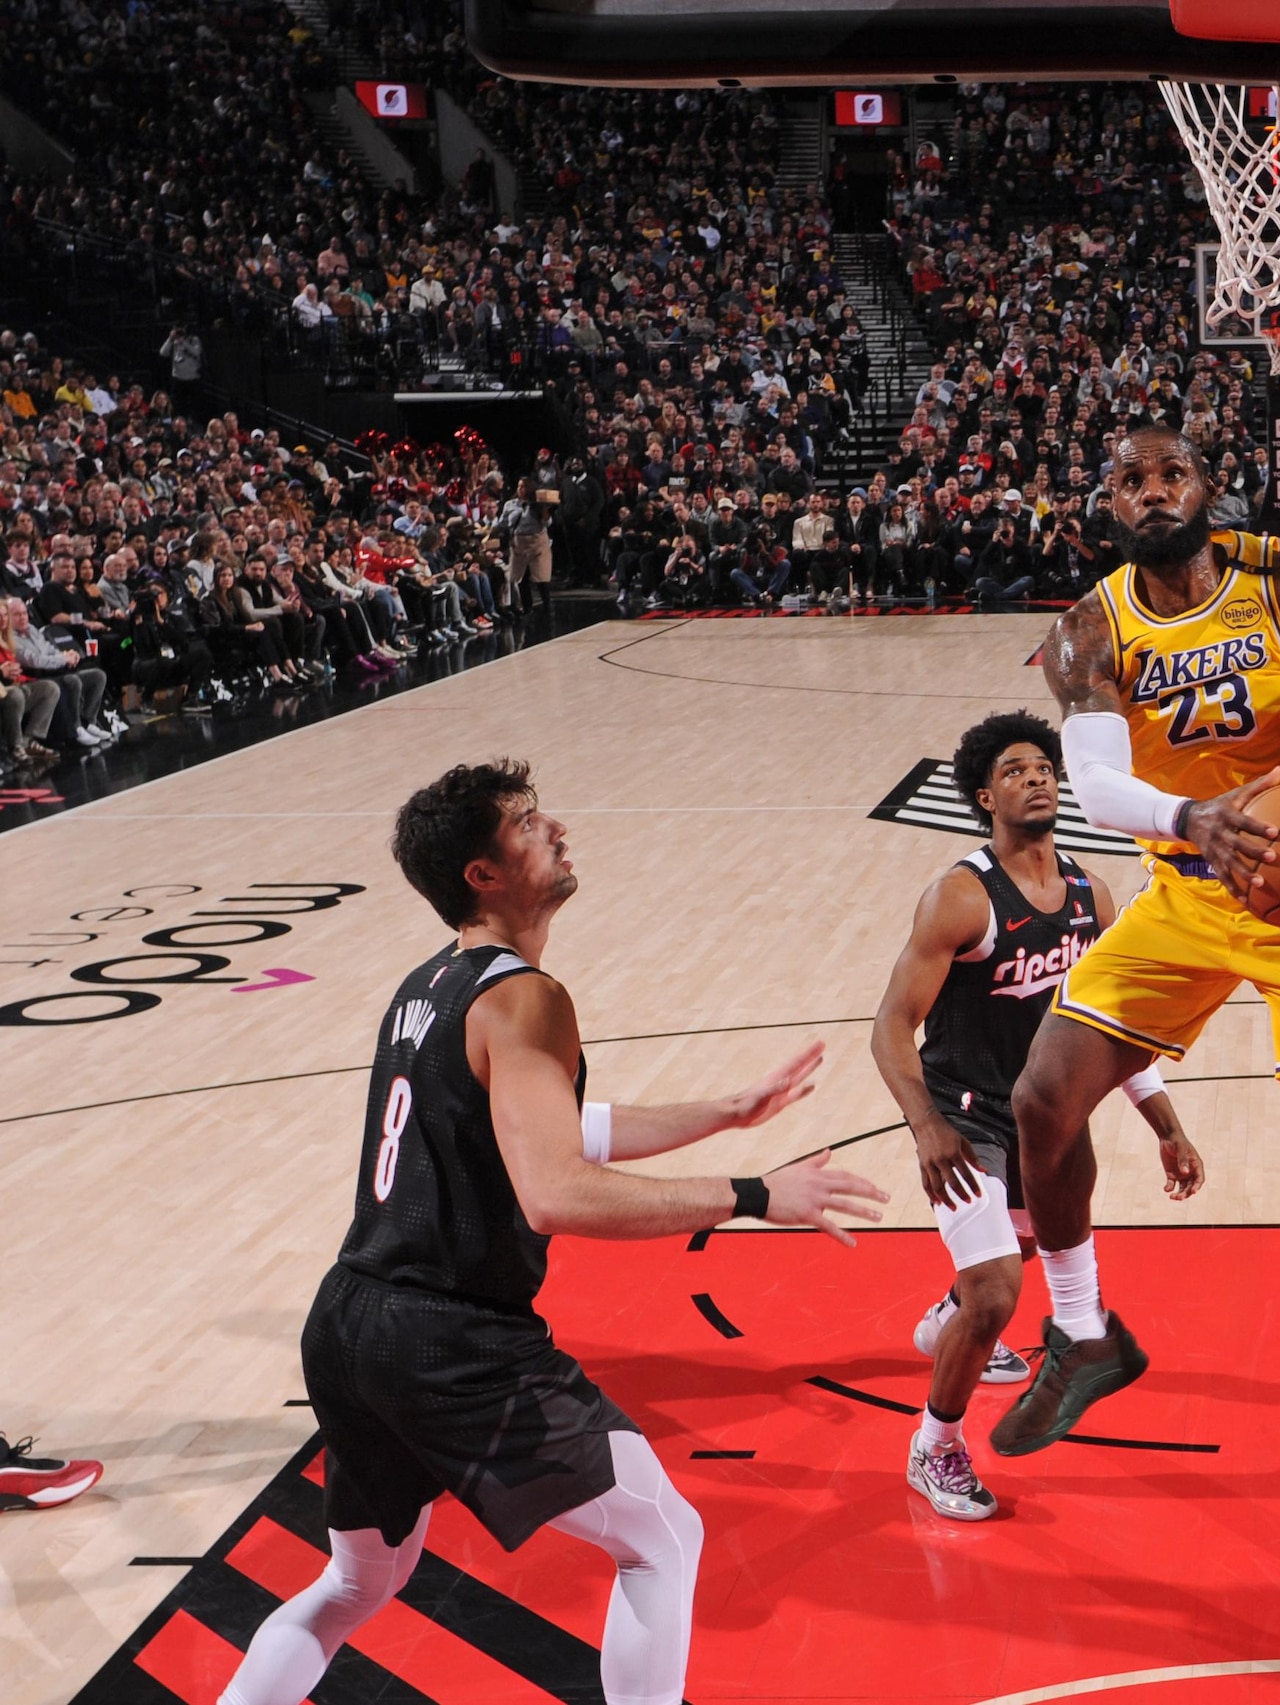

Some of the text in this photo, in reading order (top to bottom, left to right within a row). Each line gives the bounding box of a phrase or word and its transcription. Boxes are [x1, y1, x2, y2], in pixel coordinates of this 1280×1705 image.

[1224, 606, 1260, 620] bibigo
[1129, 632, 1269, 705] LAKERS
[1157, 672, 1259, 749] 23
[0, 884, 203, 968] cent
[0, 883, 366, 1026] moda
[374, 1075, 413, 1204] 8
